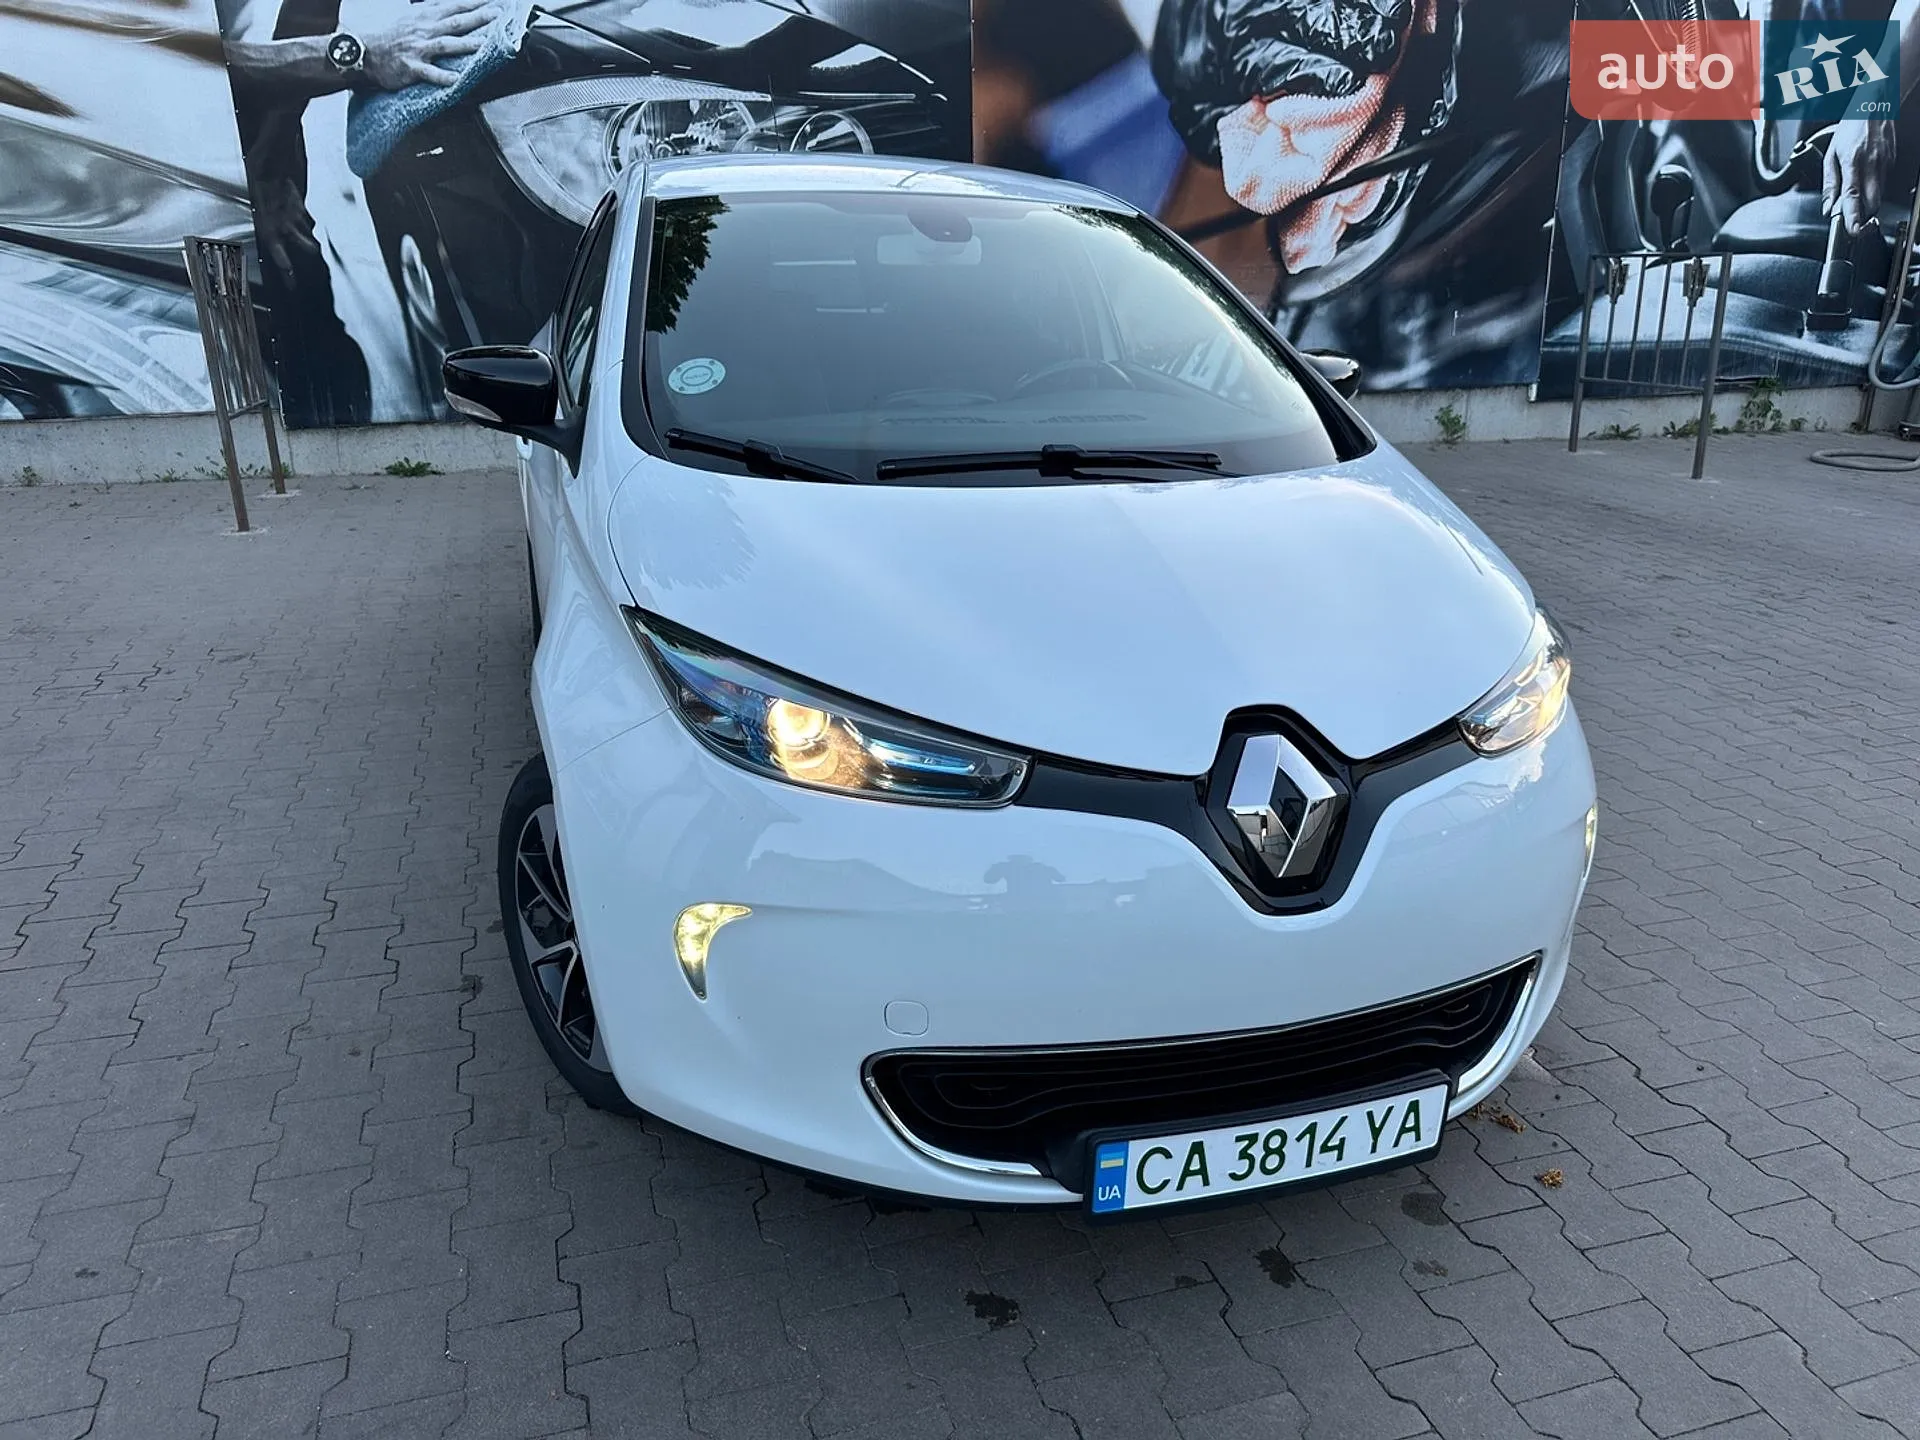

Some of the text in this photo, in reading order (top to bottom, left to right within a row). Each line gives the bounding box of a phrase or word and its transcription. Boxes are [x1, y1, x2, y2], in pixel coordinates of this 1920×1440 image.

[1135, 1099, 1422, 1195] CA 3814 YA
[1098, 1185, 1122, 1202] UA
